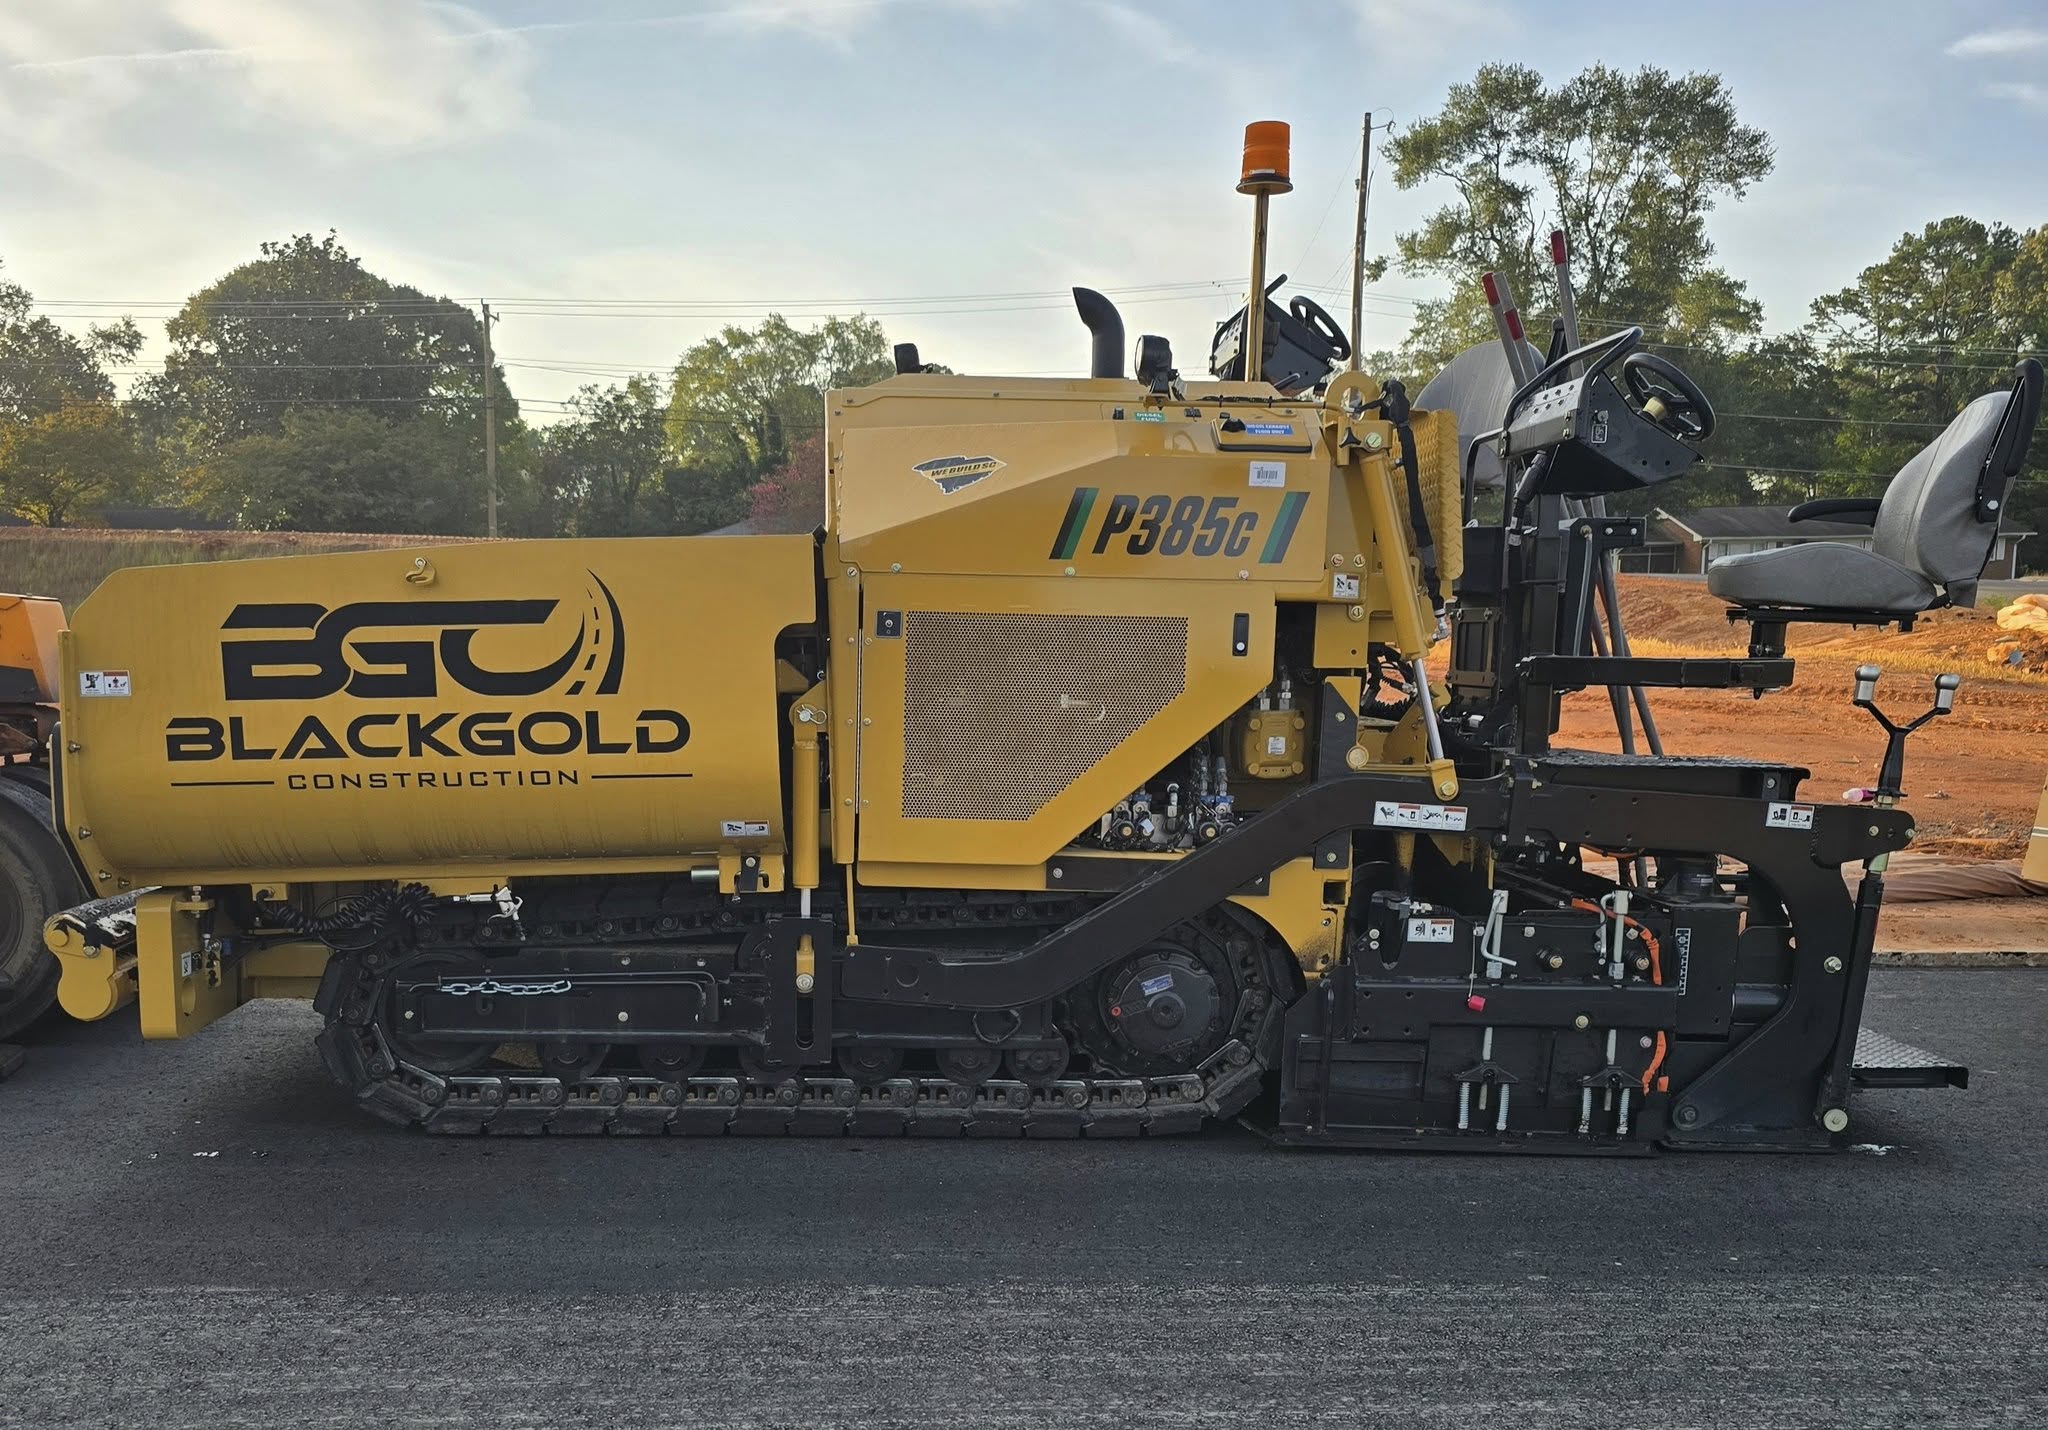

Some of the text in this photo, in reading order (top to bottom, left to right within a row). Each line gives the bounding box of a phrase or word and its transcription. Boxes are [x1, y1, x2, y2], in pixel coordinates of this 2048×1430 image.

[931, 461, 997, 477] WE BUILD SC
[166, 709, 691, 762] BLACKGOLD
[288, 769, 579, 790] CONSTRUCTION
